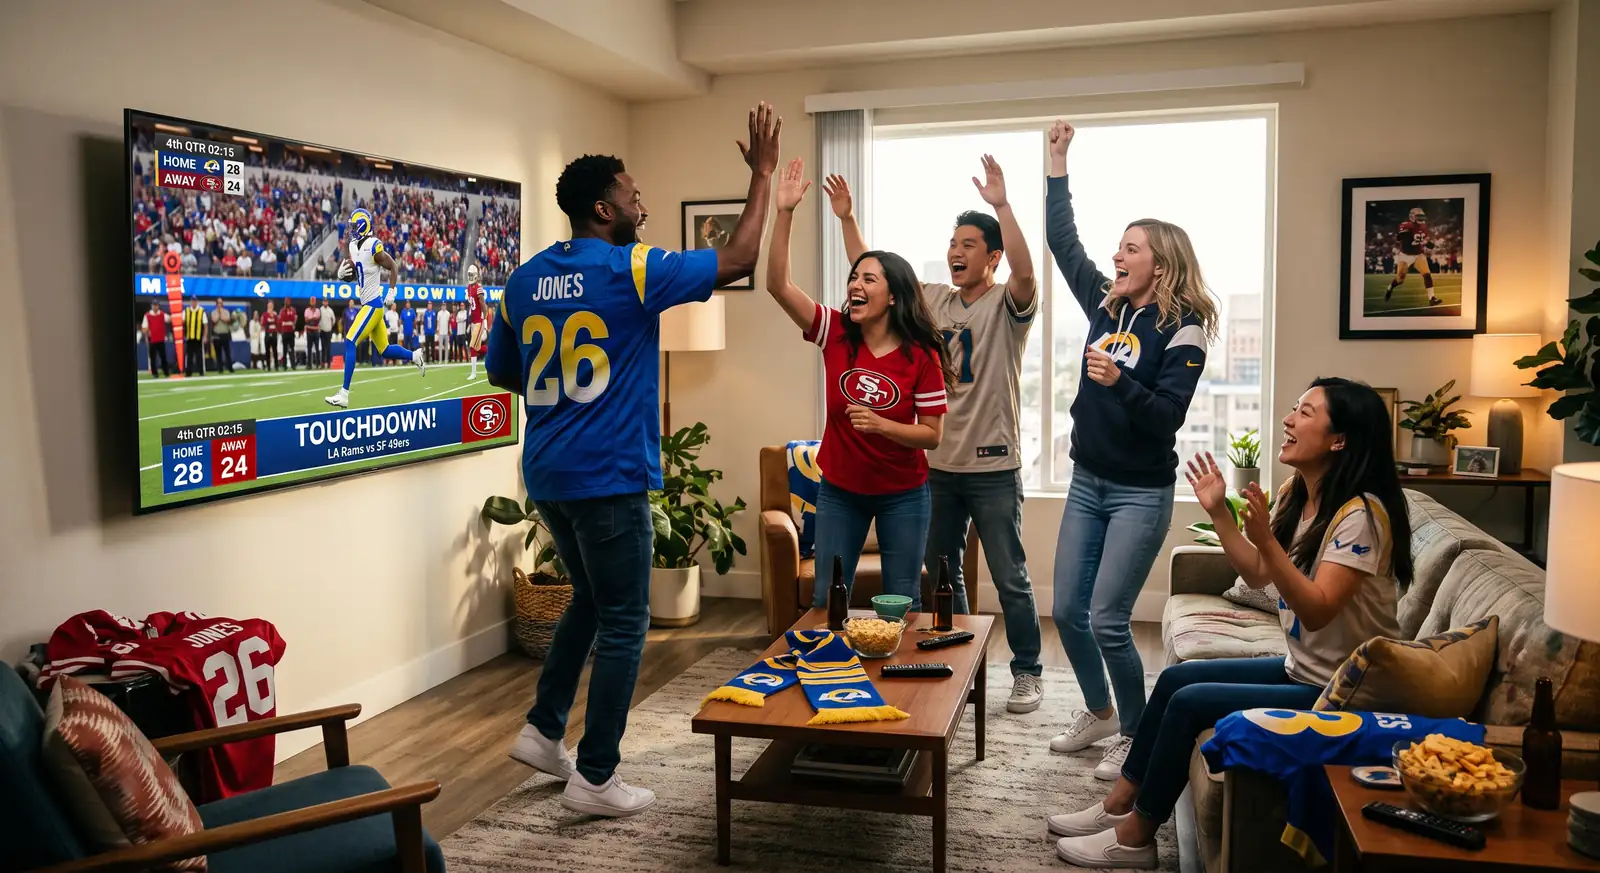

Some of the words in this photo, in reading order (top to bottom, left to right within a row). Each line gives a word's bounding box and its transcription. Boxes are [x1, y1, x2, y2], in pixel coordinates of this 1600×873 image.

[166, 138, 183, 150] 4th
[185, 141, 206, 154] QTR
[208, 144, 235, 157] 02:15
[163, 155, 197, 170] HOME
[226, 163, 240, 175] 28
[164, 173, 196, 187] AWAY
[227, 180, 241, 192] 24
[404, 286, 456, 300] DOWN
[532, 273, 584, 301] JONES
[522, 311, 611, 406] 26
[177, 429, 194, 441] 4th
[195, 426, 216, 439] QTR
[217, 423, 243, 436] 02:15
[294, 407, 437, 447] TOUCHDOWN!
[172, 445, 203, 459] HOME
[220, 439, 247, 452] AWAY
[327, 447, 340, 459] LA
[341, 444, 364, 458] Rams
[365, 443, 375, 453] vs
[376, 440, 387, 451] SF
[388, 438, 410, 449] 49ers
[173, 461, 203, 487] 28
[220, 454, 248, 479] 24
[182, 622, 243, 648] JONES
[202, 635, 275, 729] 26
